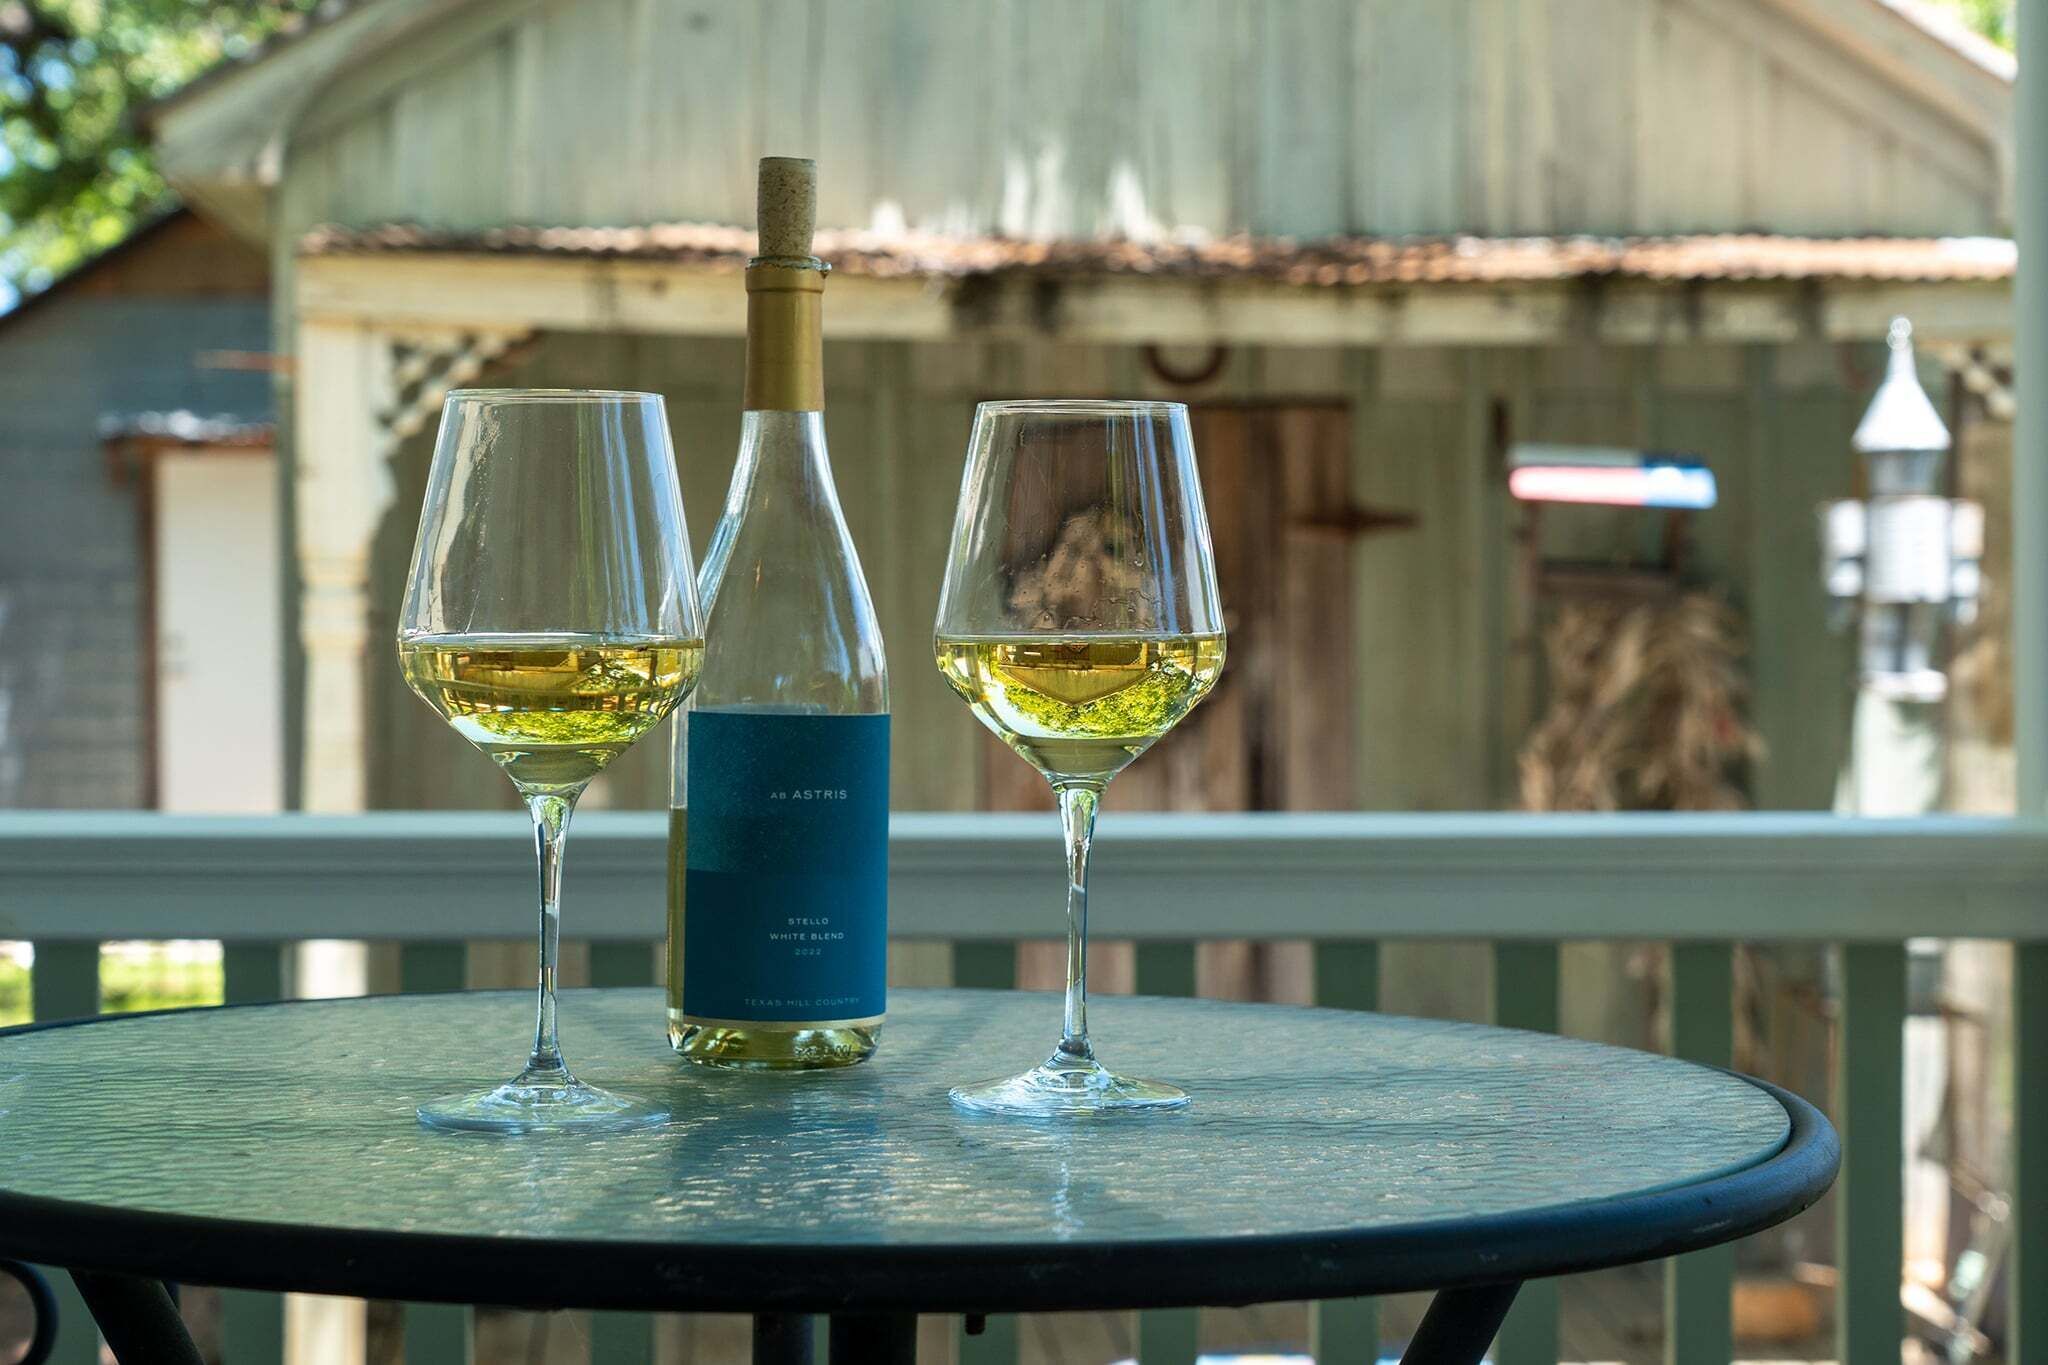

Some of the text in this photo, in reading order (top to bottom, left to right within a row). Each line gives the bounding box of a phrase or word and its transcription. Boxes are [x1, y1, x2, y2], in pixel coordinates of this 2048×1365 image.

[792, 789, 848, 800] ASTRIS
[788, 917, 829, 925] STELLO
[769, 932, 845, 941] WHITE BLEND
[744, 998, 783, 1007] TEXAS
[786, 999, 810, 1007] HILL
